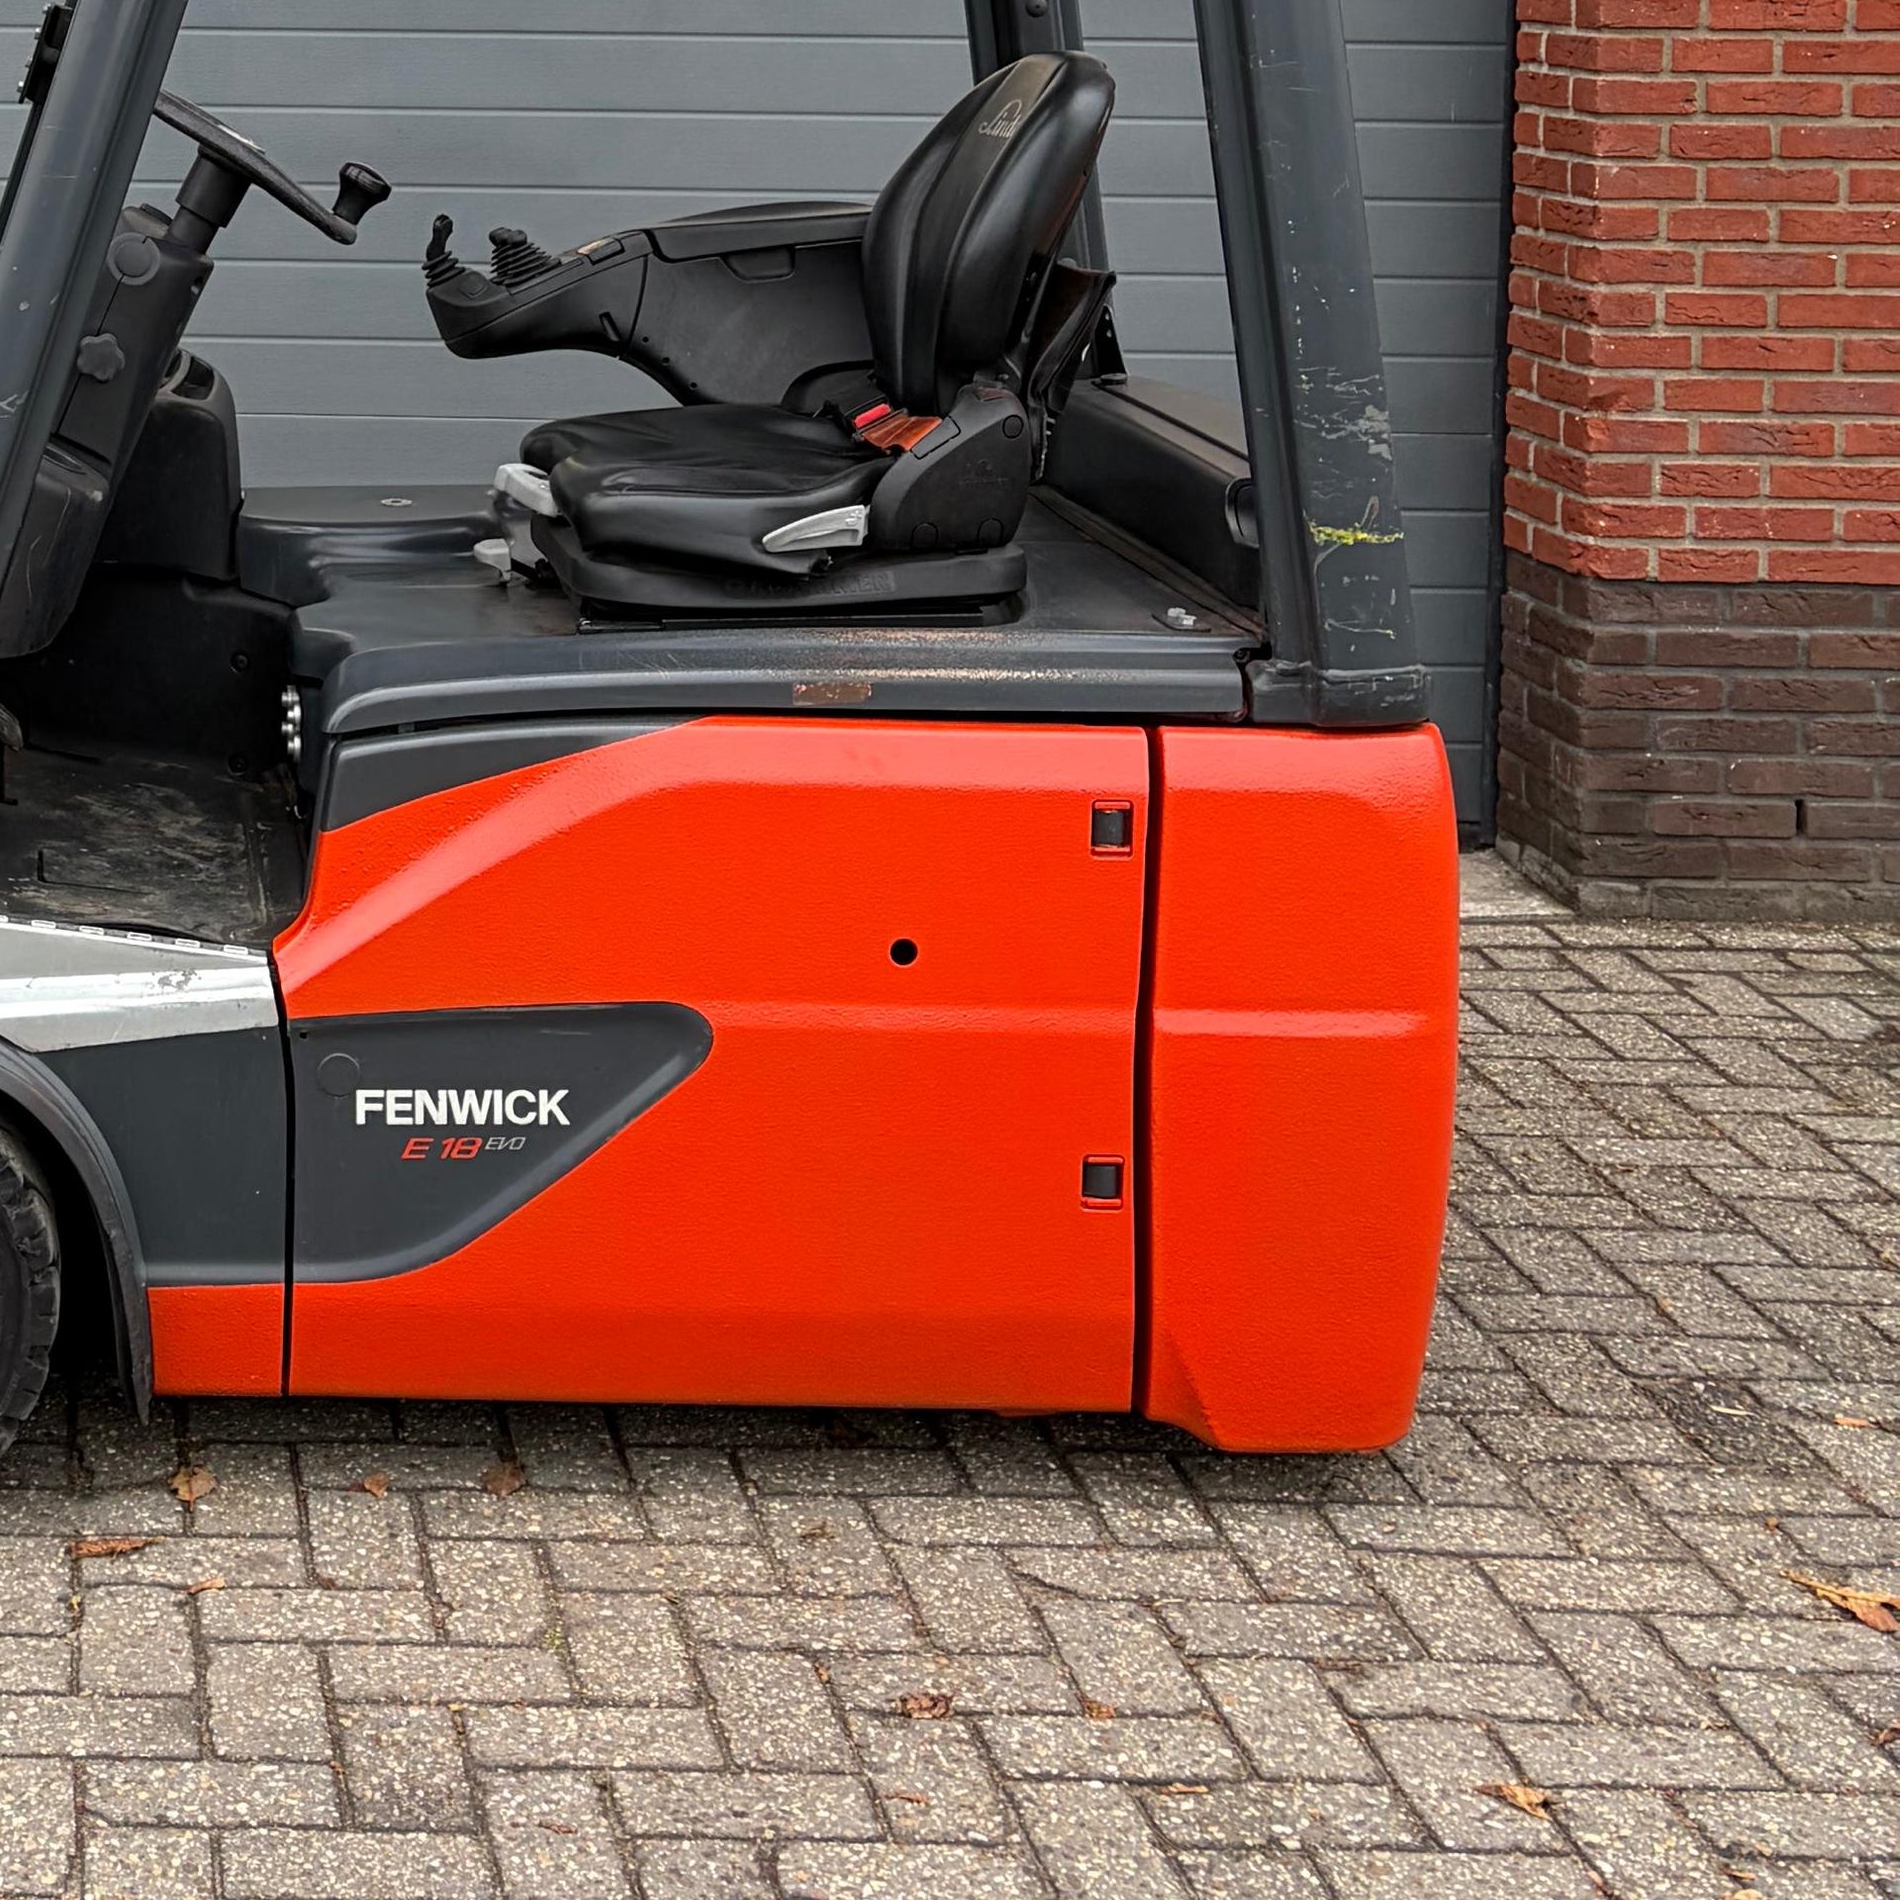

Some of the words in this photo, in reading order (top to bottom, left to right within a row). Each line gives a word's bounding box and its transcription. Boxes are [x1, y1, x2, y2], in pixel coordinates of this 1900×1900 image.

[978, 99, 1022, 138] Lind
[355, 1089, 571, 1126] FENWICK
[401, 1137, 435, 1161] E
[440, 1137, 483, 1161] 18
[484, 1136, 527, 1151] EVO
